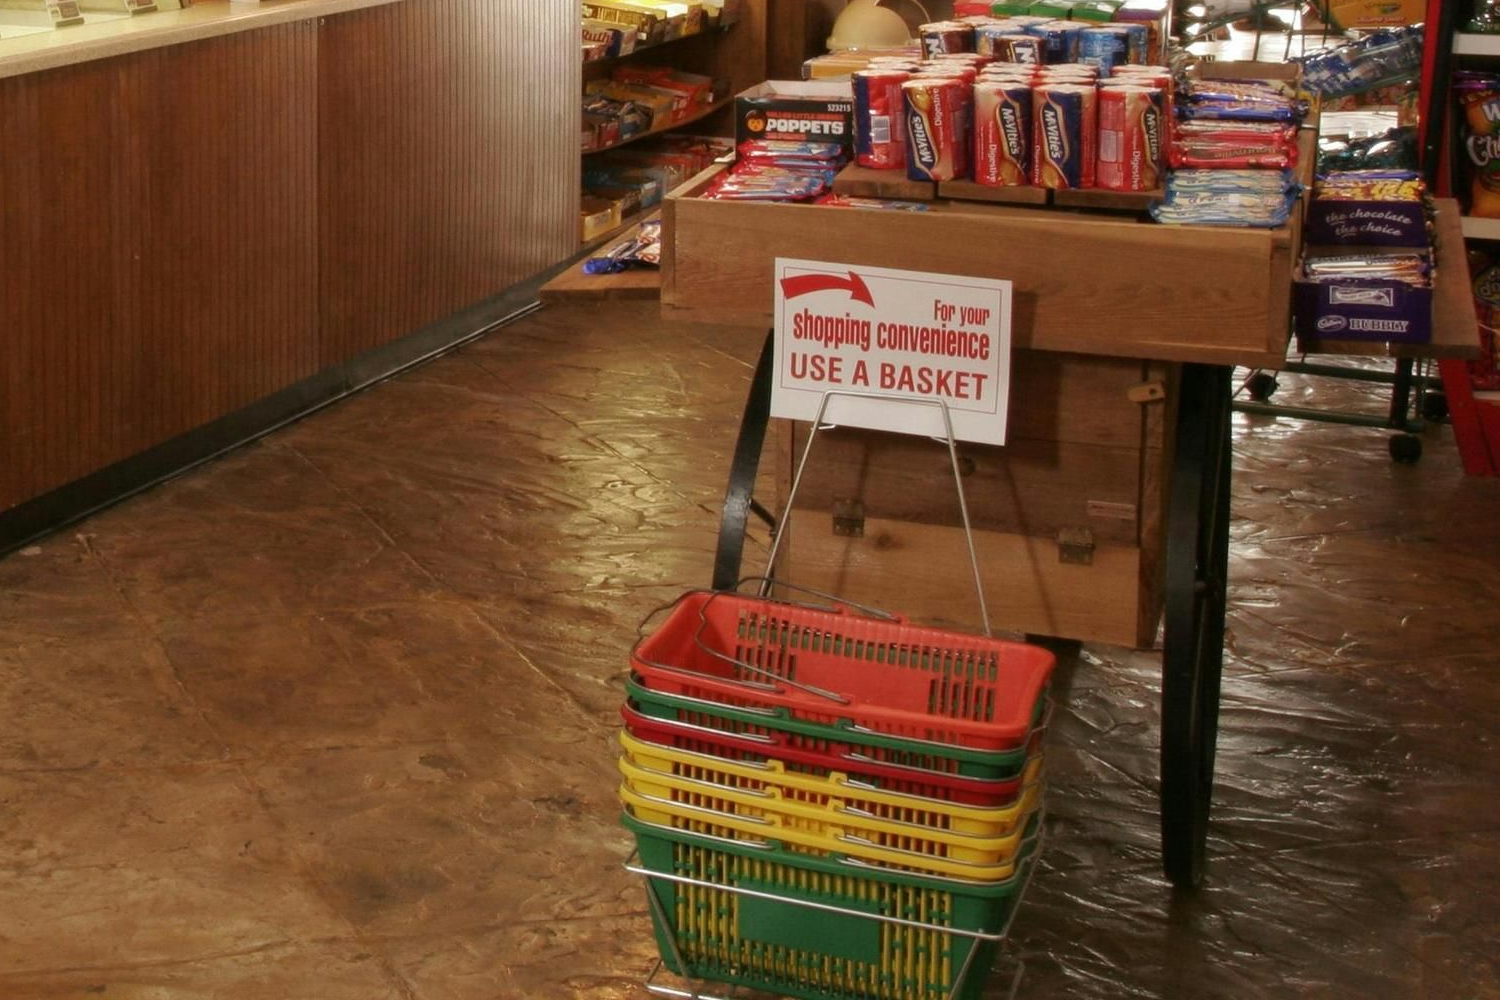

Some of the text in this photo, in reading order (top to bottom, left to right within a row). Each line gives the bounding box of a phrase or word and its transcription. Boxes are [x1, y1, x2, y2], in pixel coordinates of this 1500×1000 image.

[765, 119, 844, 134] POPPETS
[987, 144, 998, 183] Digestive
[1131, 151, 1141, 190] Digestive
[1349, 209, 1412, 224] chocolate
[1360, 222, 1404, 235] choice
[934, 299, 989, 327] For your
[793, 309, 989, 360] shopping convenience
[790, 352, 988, 401] USE A BASKET
